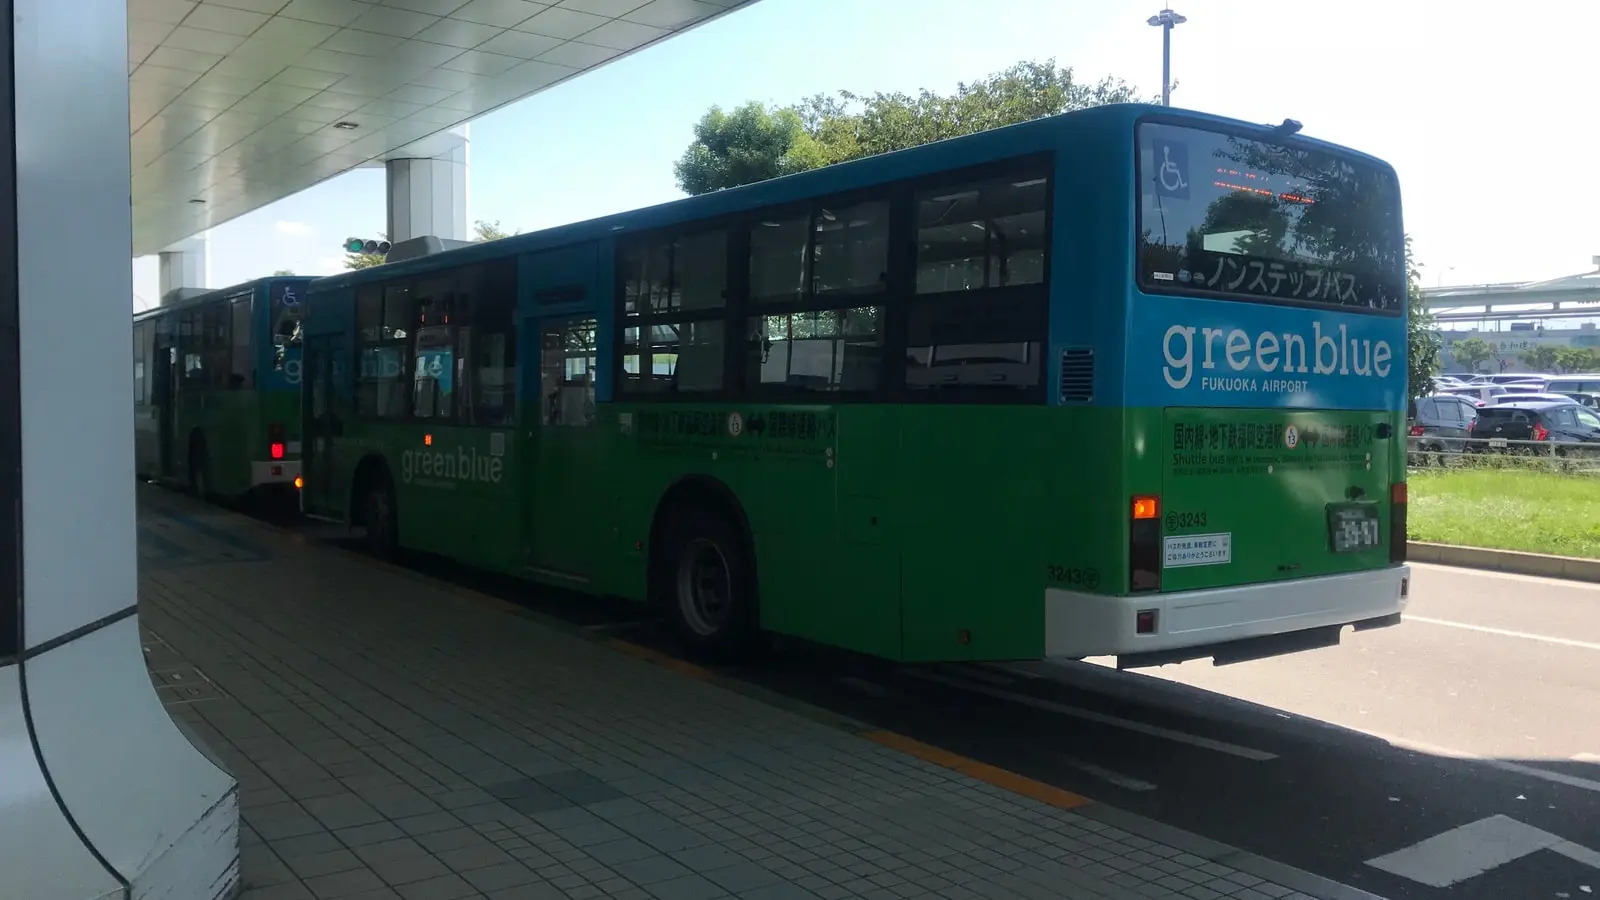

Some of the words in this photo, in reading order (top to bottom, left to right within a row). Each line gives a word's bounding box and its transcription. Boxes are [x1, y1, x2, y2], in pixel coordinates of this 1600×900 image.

[1207, 256, 1359, 302] ノンステップバス
[1202, 377, 1258, 392] FUKUOKA
[1262, 379, 1308, 393] AIRPORT
[1173, 453, 1207, 466] Shuttle
[1209, 453, 1226, 465] bus
[1180, 512, 1207, 528] 3243
[1047, 564, 1082, 585] 3243
